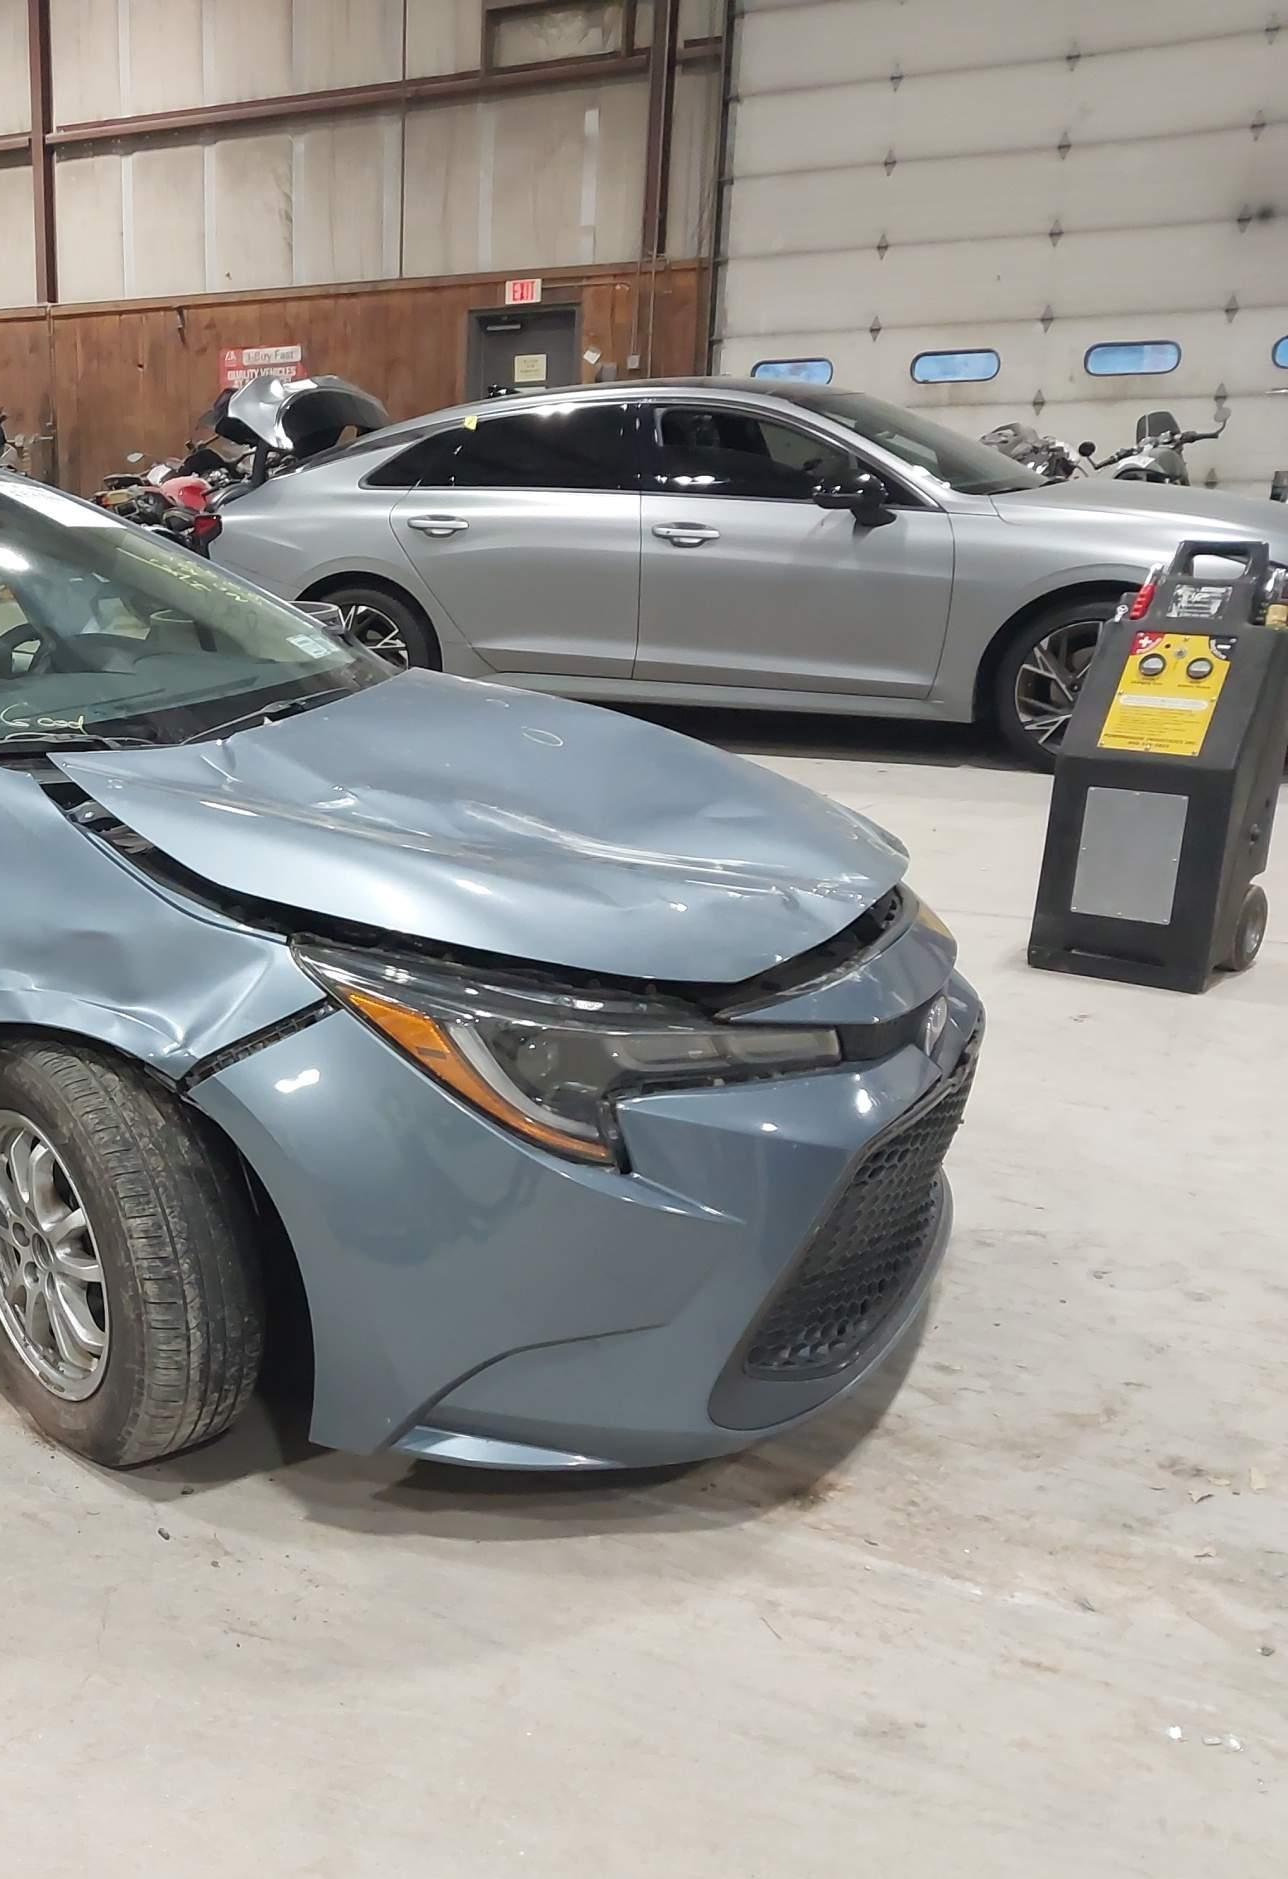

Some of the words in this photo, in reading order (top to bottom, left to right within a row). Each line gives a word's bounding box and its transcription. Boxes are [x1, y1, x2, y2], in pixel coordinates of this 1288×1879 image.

[512, 281, 536, 301] EXIT
[227, 368, 259, 381] QUALITY
[260, 366, 296, 377] VEHICLES
[0, 702, 89, 735] Good
